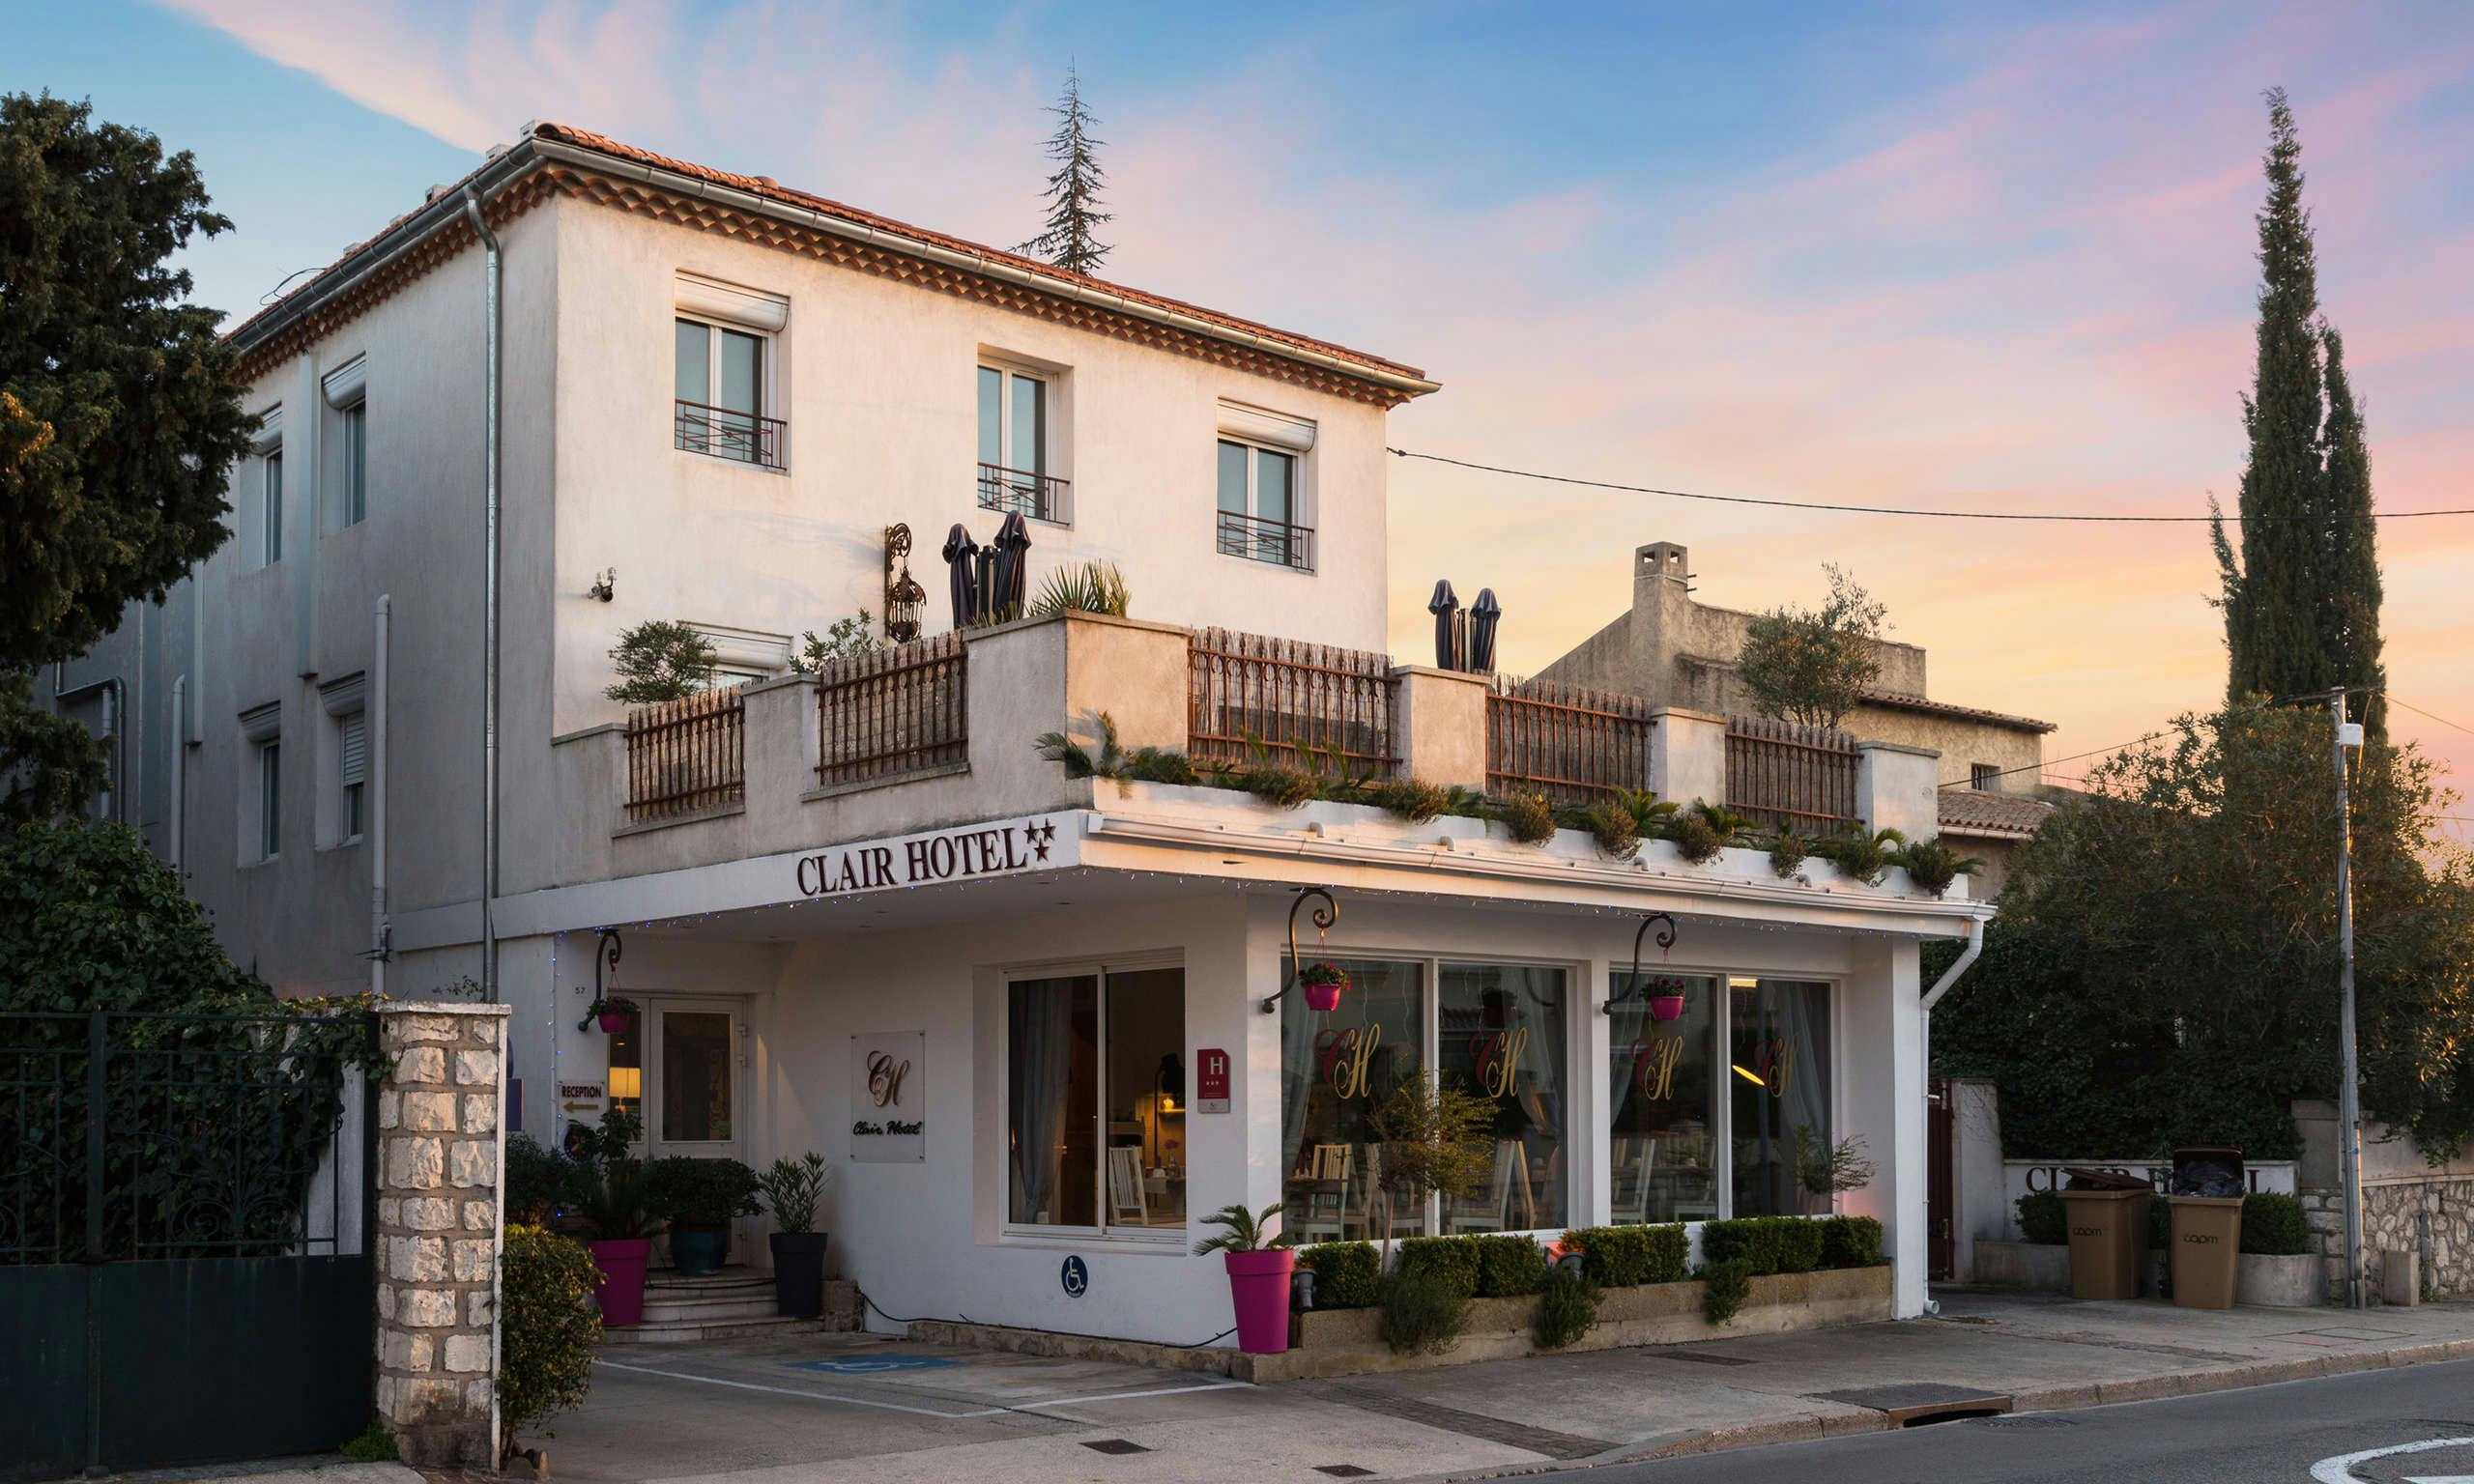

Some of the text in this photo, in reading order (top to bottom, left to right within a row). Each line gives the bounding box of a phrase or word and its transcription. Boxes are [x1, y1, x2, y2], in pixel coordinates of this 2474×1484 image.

[796, 827, 1028, 896] CLAIR HOTEL
[1210, 1056, 1223, 1075] H
[561, 1085, 602, 1099] RECEPTION
[886, 1121, 923, 1135] Hotel
